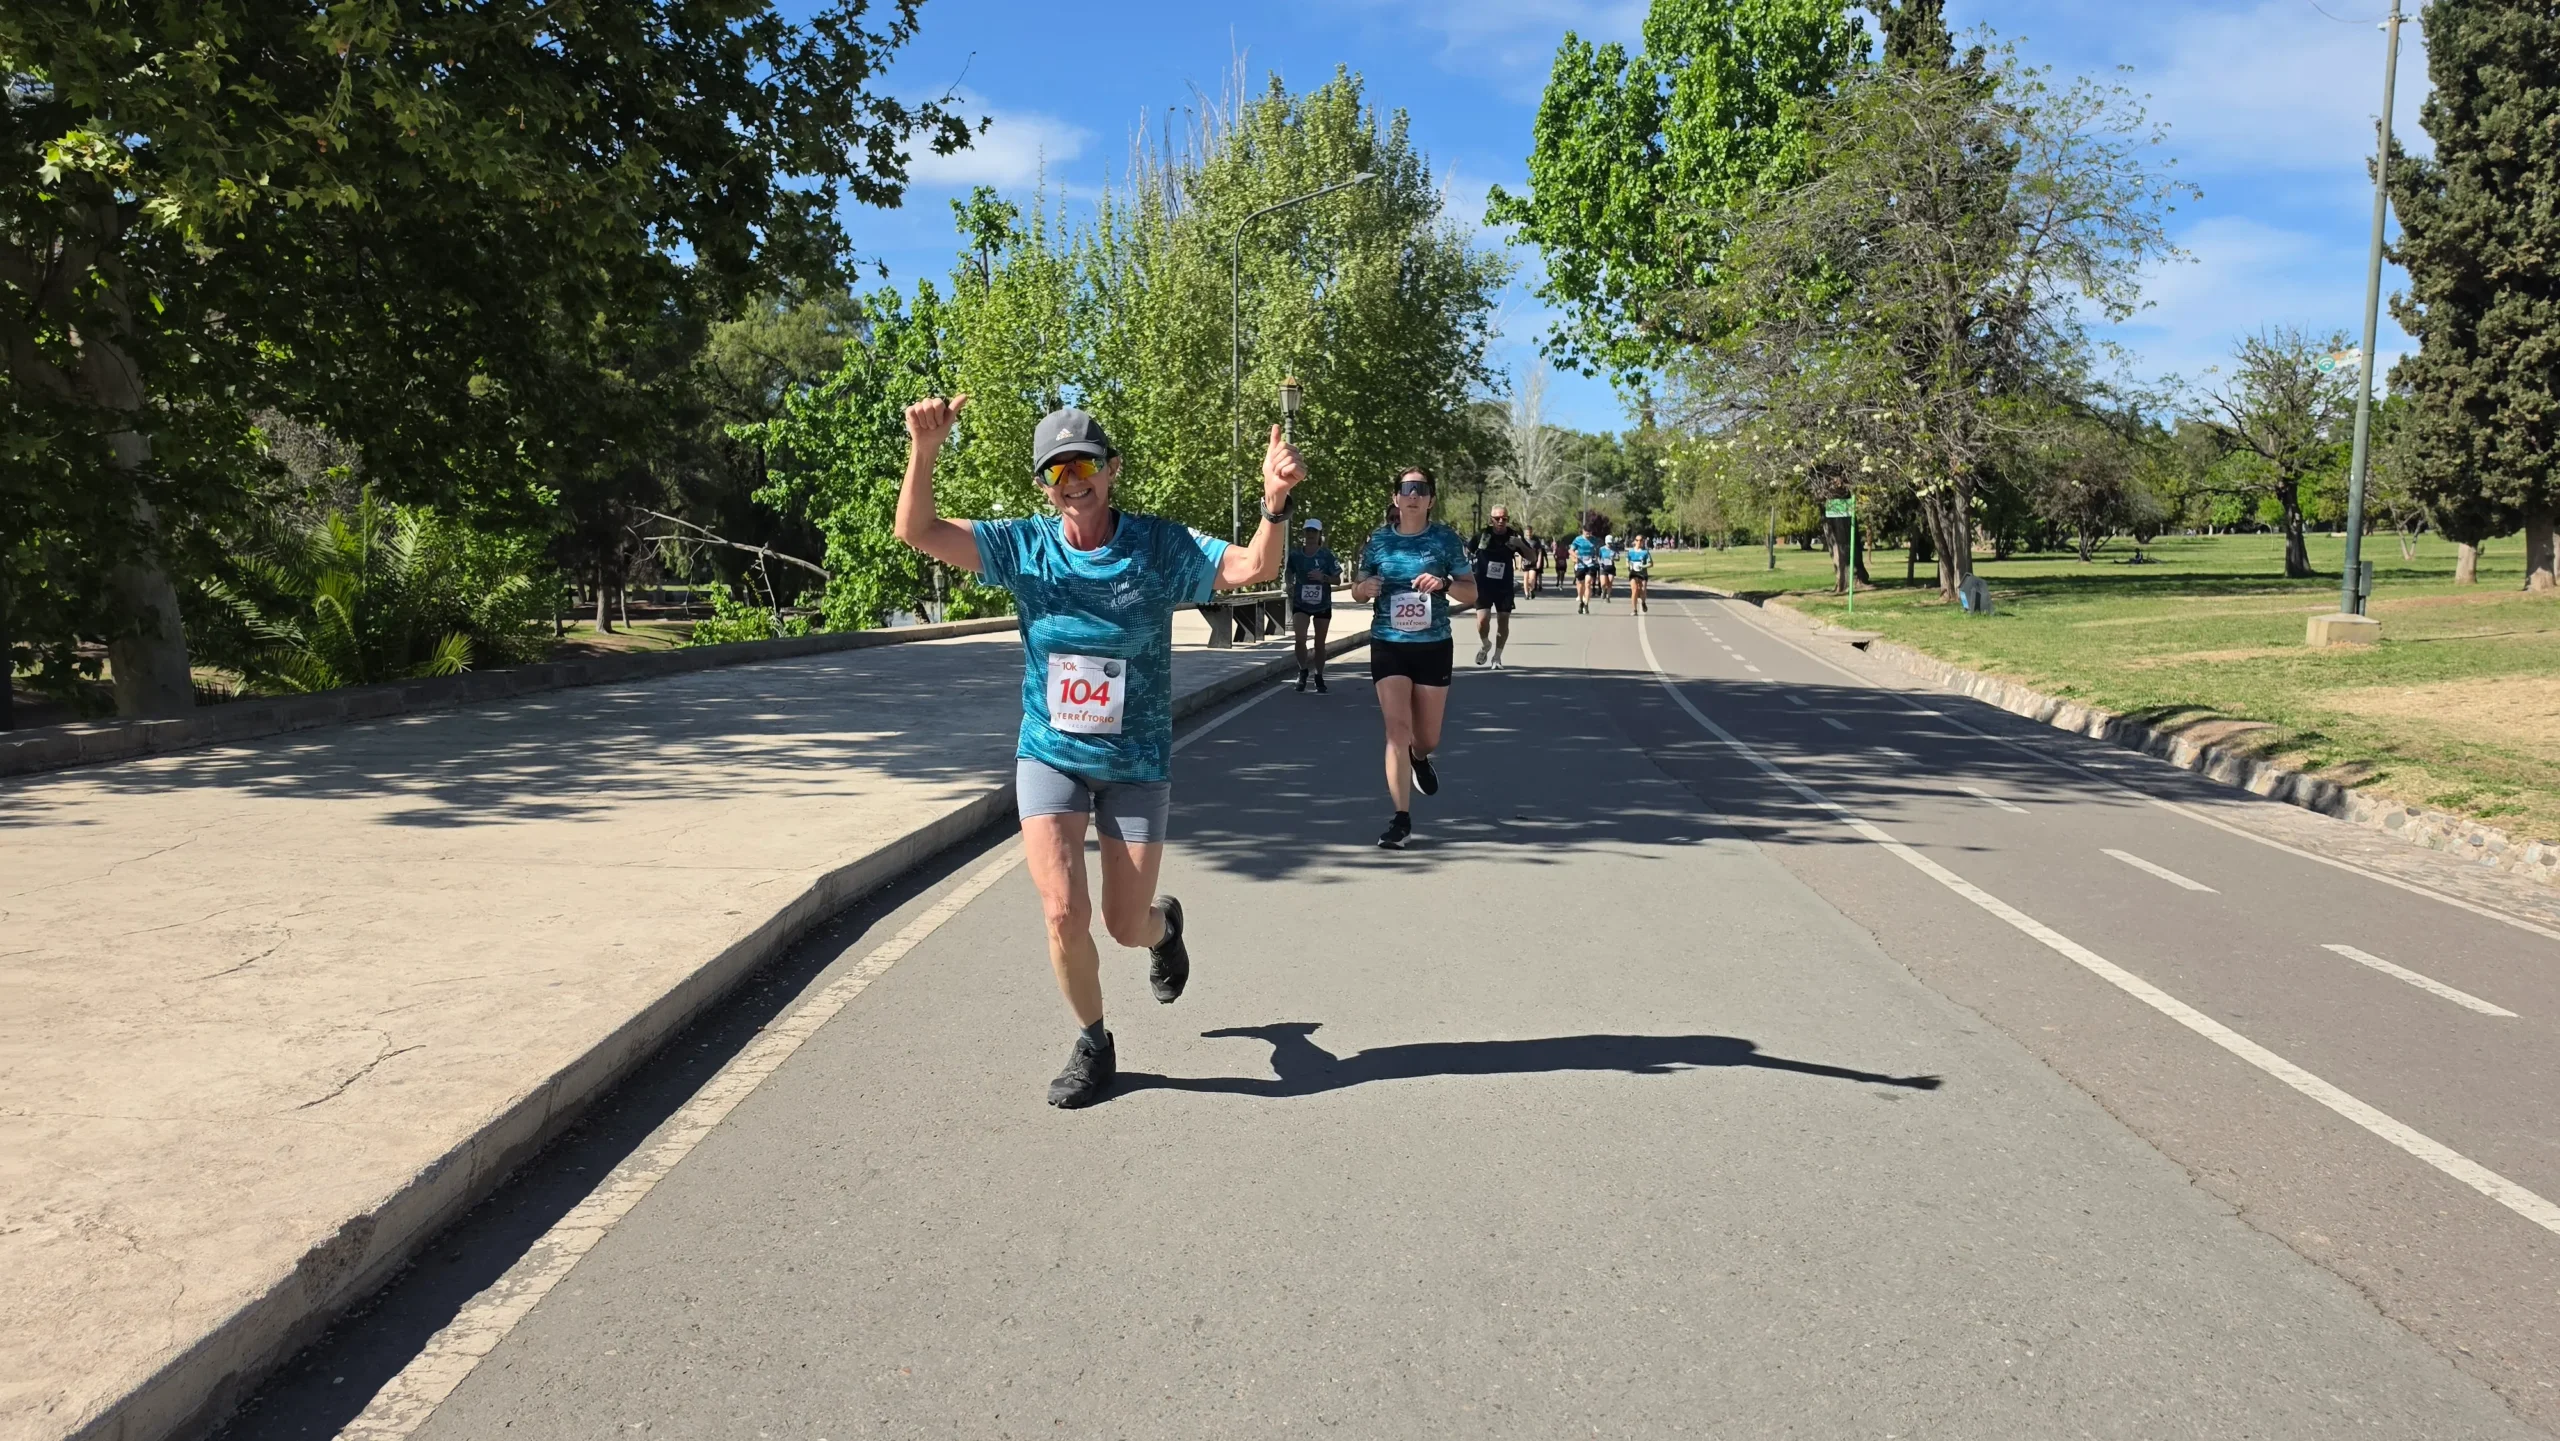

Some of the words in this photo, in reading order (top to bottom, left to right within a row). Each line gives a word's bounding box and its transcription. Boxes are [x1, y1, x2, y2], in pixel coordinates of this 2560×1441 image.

[1303, 590, 1320, 598] 209
[1395, 603, 1426, 618] 283
[1060, 678, 1111, 707] 104
[1057, 710, 1115, 723] TERRITORIO
